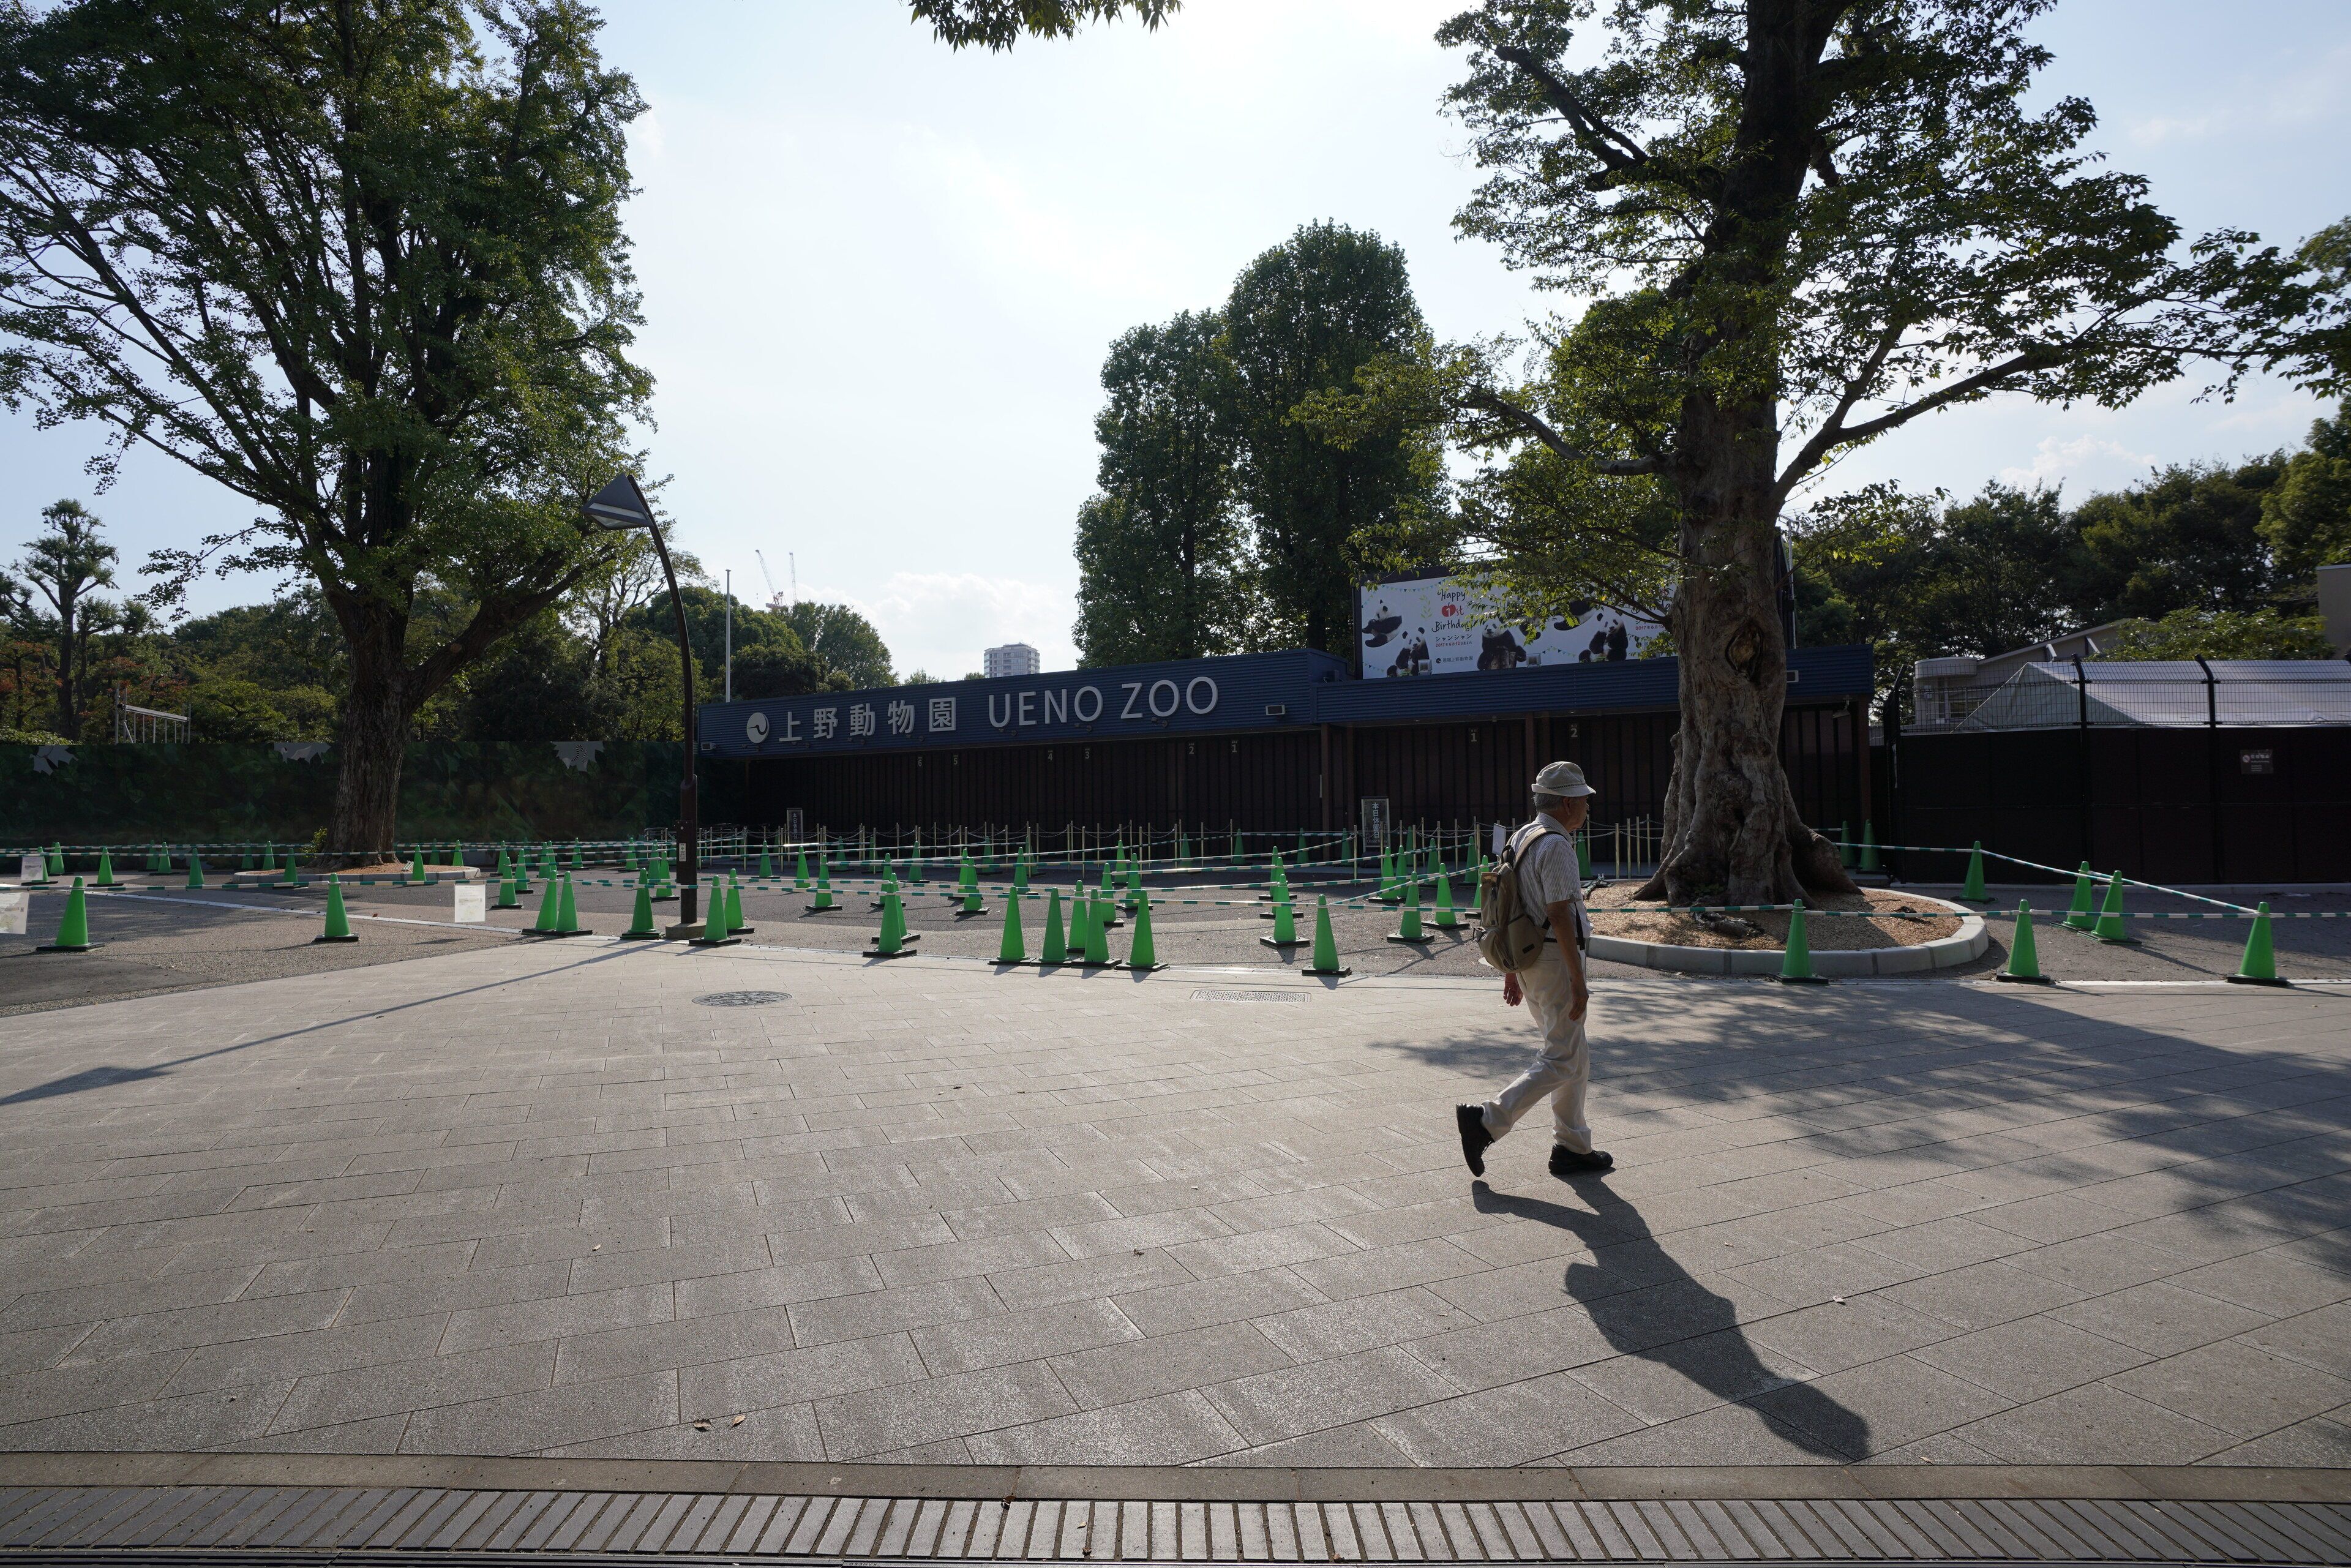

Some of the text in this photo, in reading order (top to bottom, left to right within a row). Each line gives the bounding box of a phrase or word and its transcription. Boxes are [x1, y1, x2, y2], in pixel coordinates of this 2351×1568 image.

[1438, 589, 1466, 602] Happy
[1445, 606, 1464, 617] 1st
[779, 676, 1218, 741] 上野動物園 UENO ZOO
[1471, 732, 1477, 742] 1
[1570, 727, 1578, 738] 2
[1189, 746, 1194, 754] 2
[1232, 744, 1237, 752] 1
[1085, 751, 1090, 759] 3
